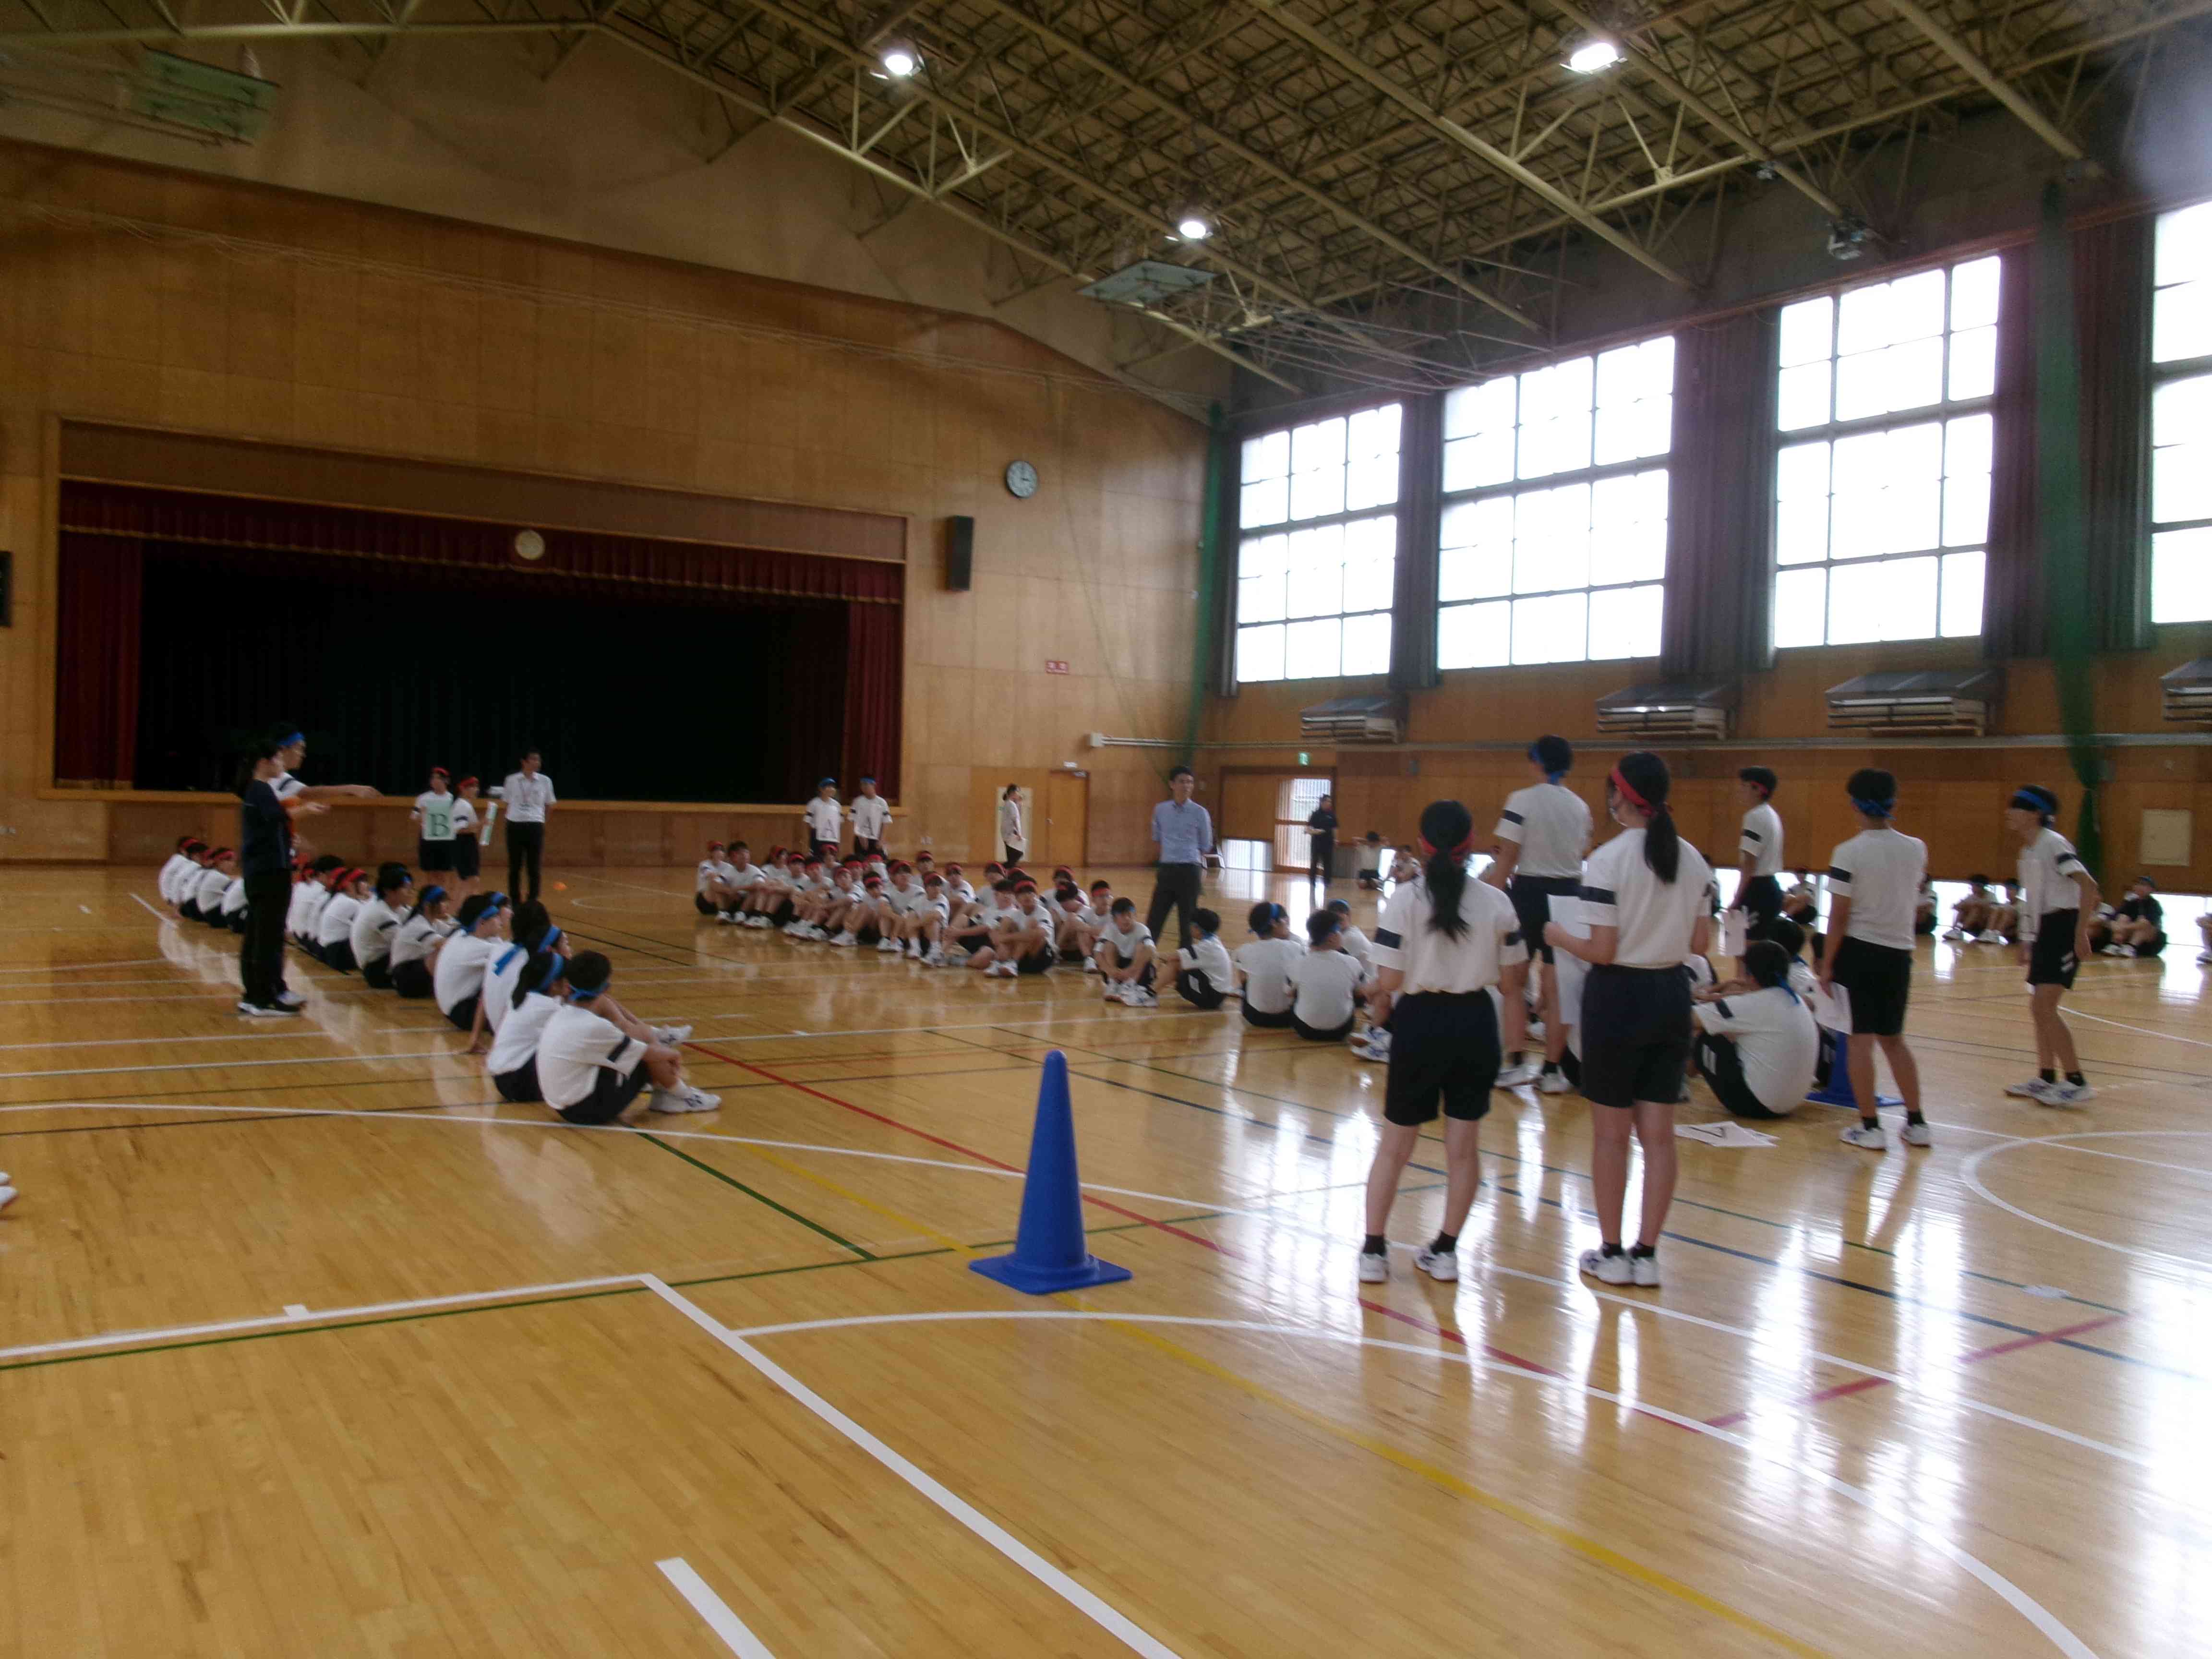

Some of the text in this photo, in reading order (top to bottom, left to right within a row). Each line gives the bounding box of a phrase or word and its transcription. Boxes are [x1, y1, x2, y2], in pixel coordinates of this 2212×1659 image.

[429, 814, 450, 837] B
[821, 818, 837, 838] A
[861, 816, 875, 836] A
